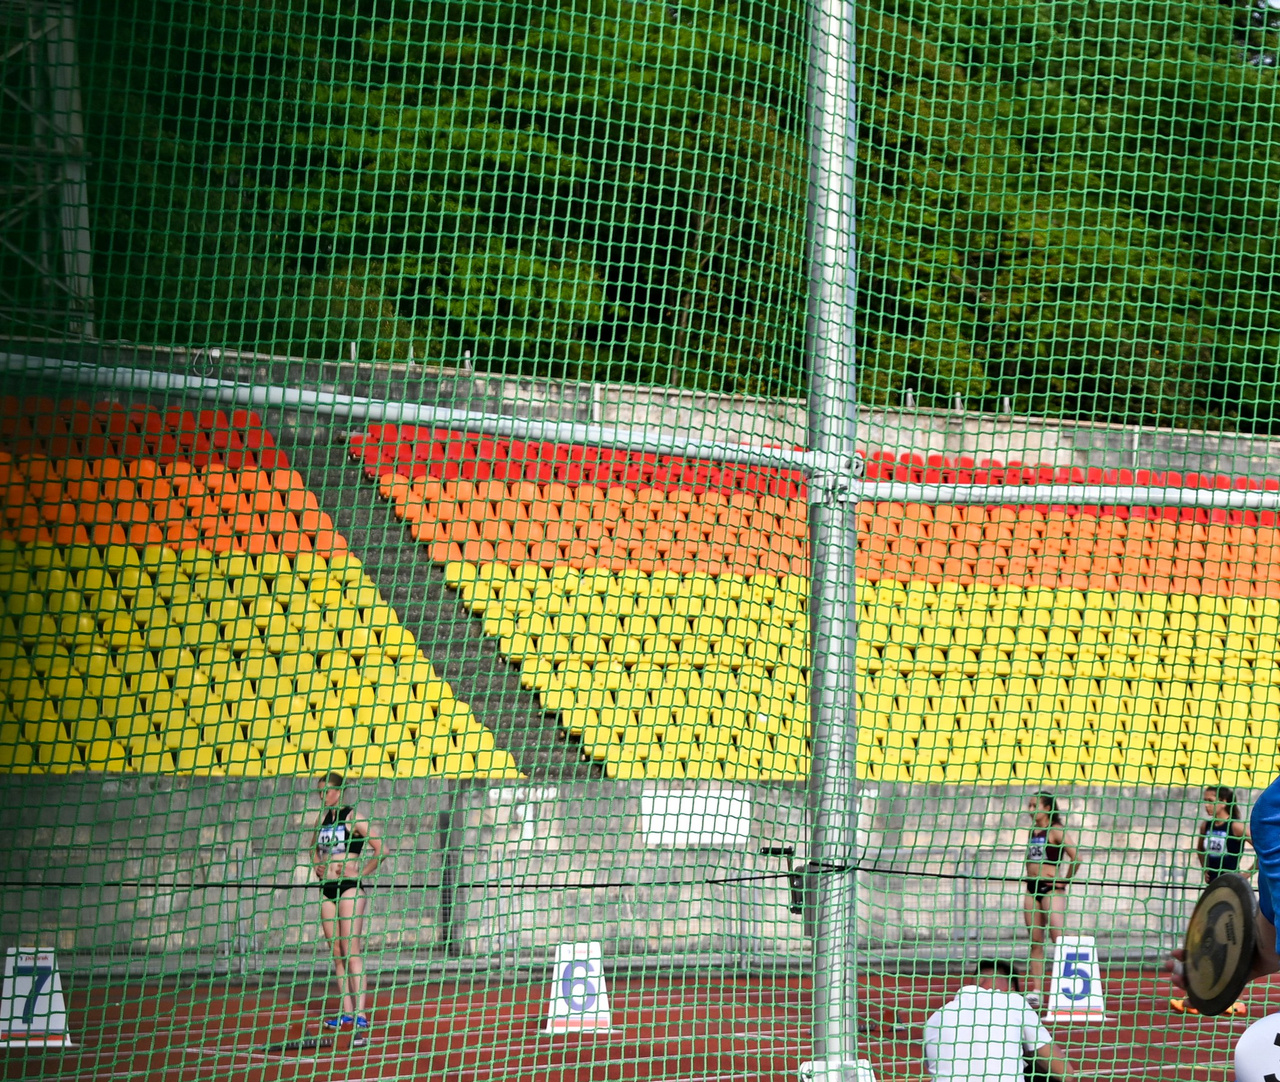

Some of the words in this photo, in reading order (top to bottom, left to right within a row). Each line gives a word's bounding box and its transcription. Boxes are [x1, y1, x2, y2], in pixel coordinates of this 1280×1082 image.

[13, 966, 52, 1024] 7
[562, 961, 596, 1011] 6
[1062, 953, 1091, 1001] 5
